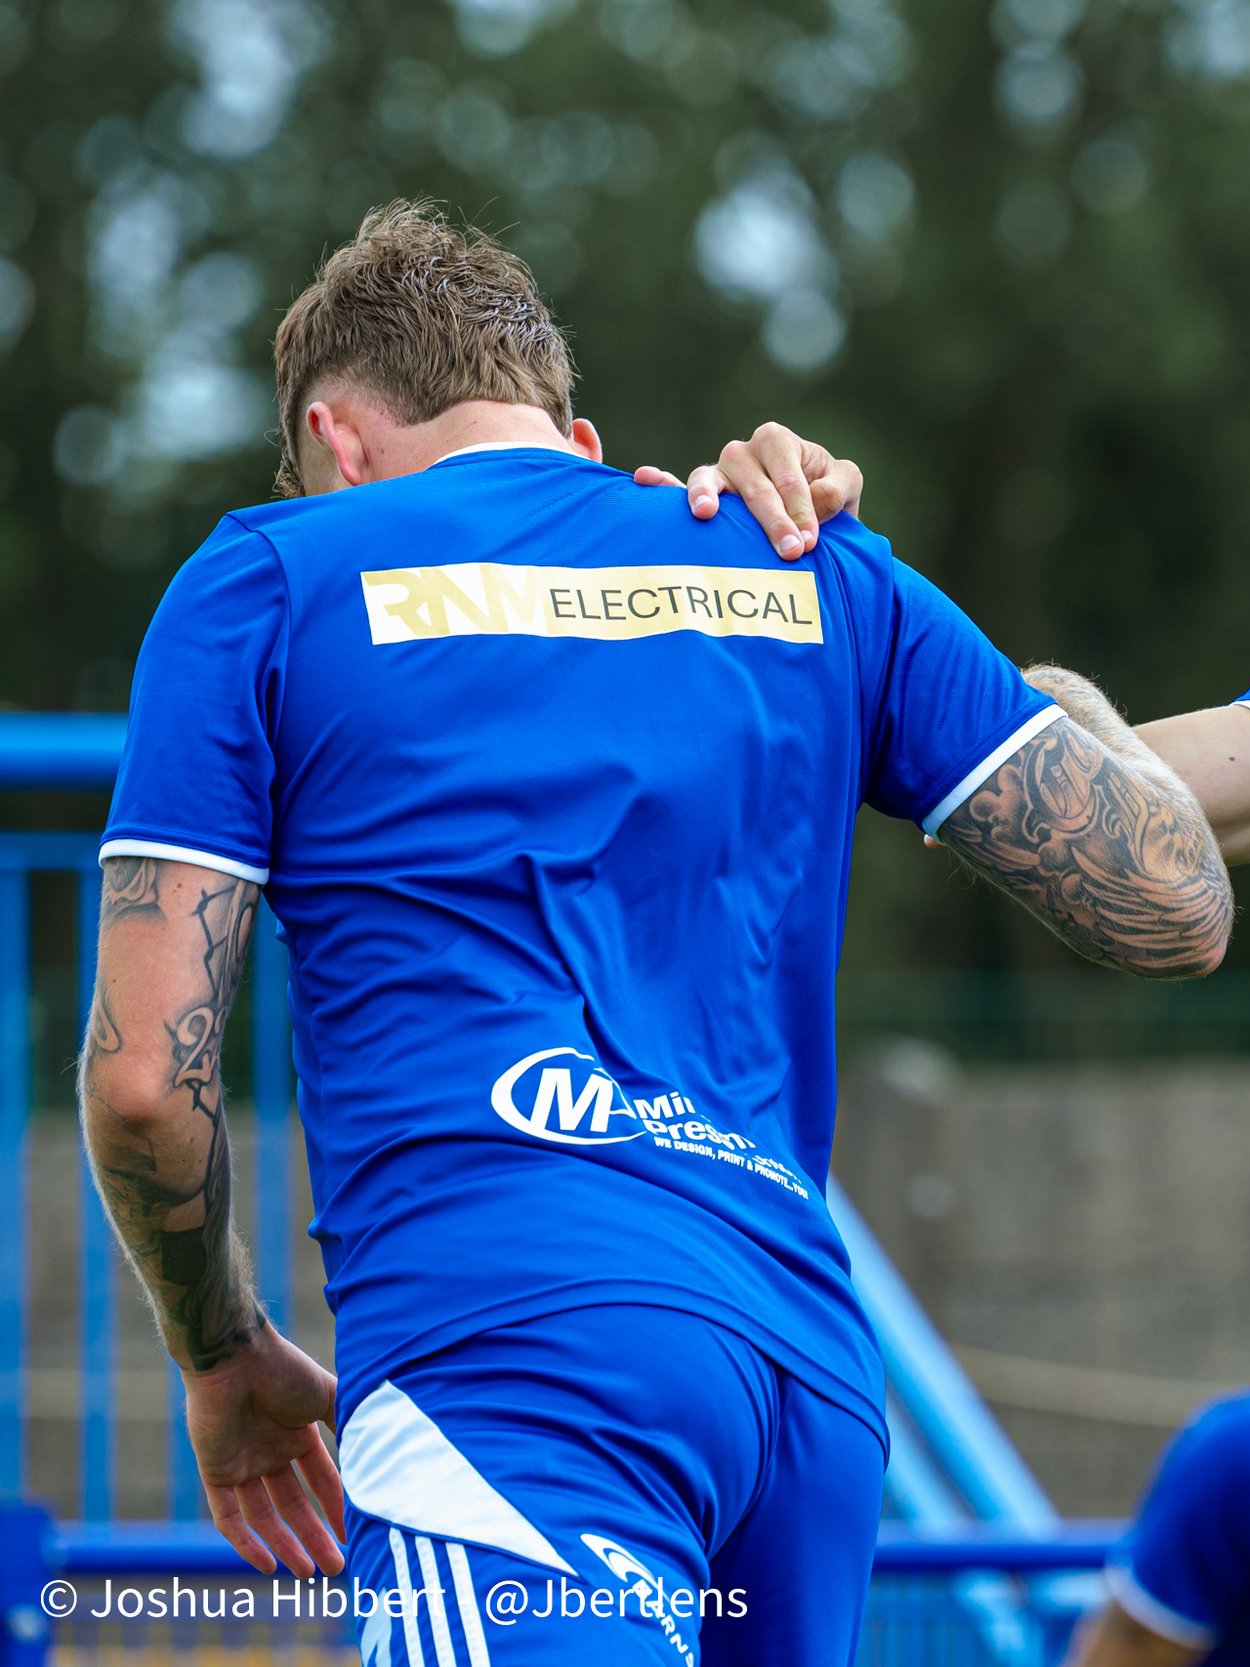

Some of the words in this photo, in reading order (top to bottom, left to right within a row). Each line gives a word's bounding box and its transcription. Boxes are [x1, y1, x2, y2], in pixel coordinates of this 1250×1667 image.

[549, 585, 813, 626] ELECTRICAL
[653, 1136, 673, 1149] WE
[673, 1140, 717, 1160] DESIGN,
[717, 1149, 746, 1167] PRINT
